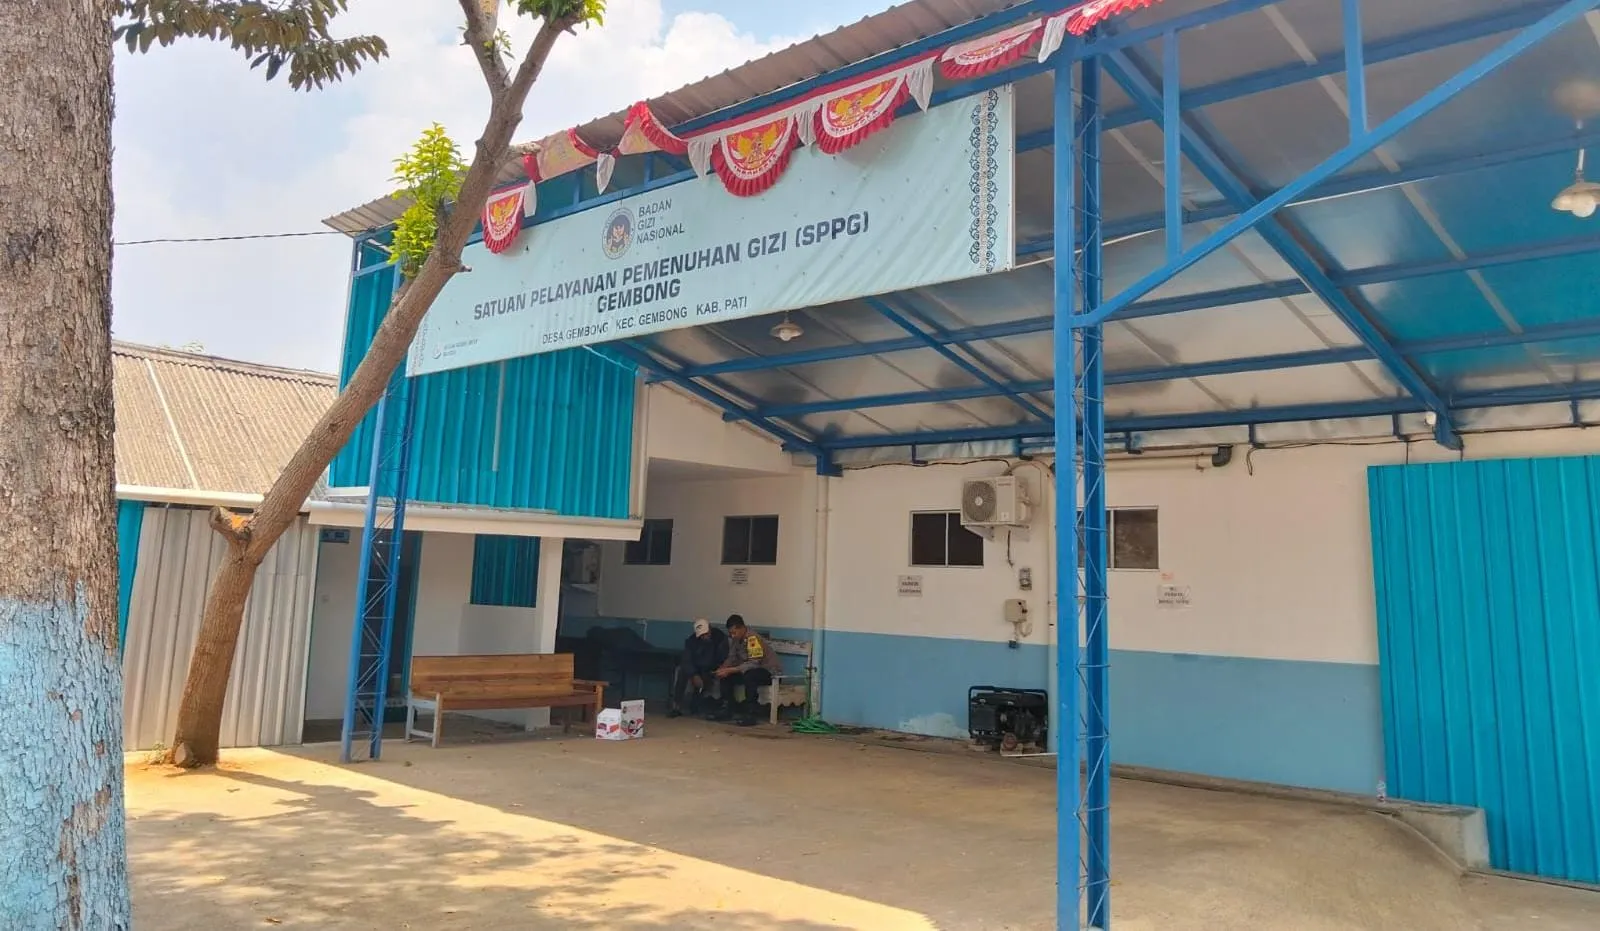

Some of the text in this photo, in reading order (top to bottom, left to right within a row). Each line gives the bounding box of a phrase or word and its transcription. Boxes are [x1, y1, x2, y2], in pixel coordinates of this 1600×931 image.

[638, 198, 672, 217] BADAN
[636, 223, 685, 244] NASIONAL
[637, 217, 656, 230] GIZI
[474, 211, 869, 320] SATUAN PELAYANAN PEMENUHAN GIZI (SPPG)
[597, 278, 681, 314] GEMBONG
[542, 331, 564, 345] DESA
[566, 322, 608, 340] GEMBONG
[638, 306, 687, 325] GEMBONG
[696, 301, 721, 316] KAB.
[725, 296, 747, 310] PATI
